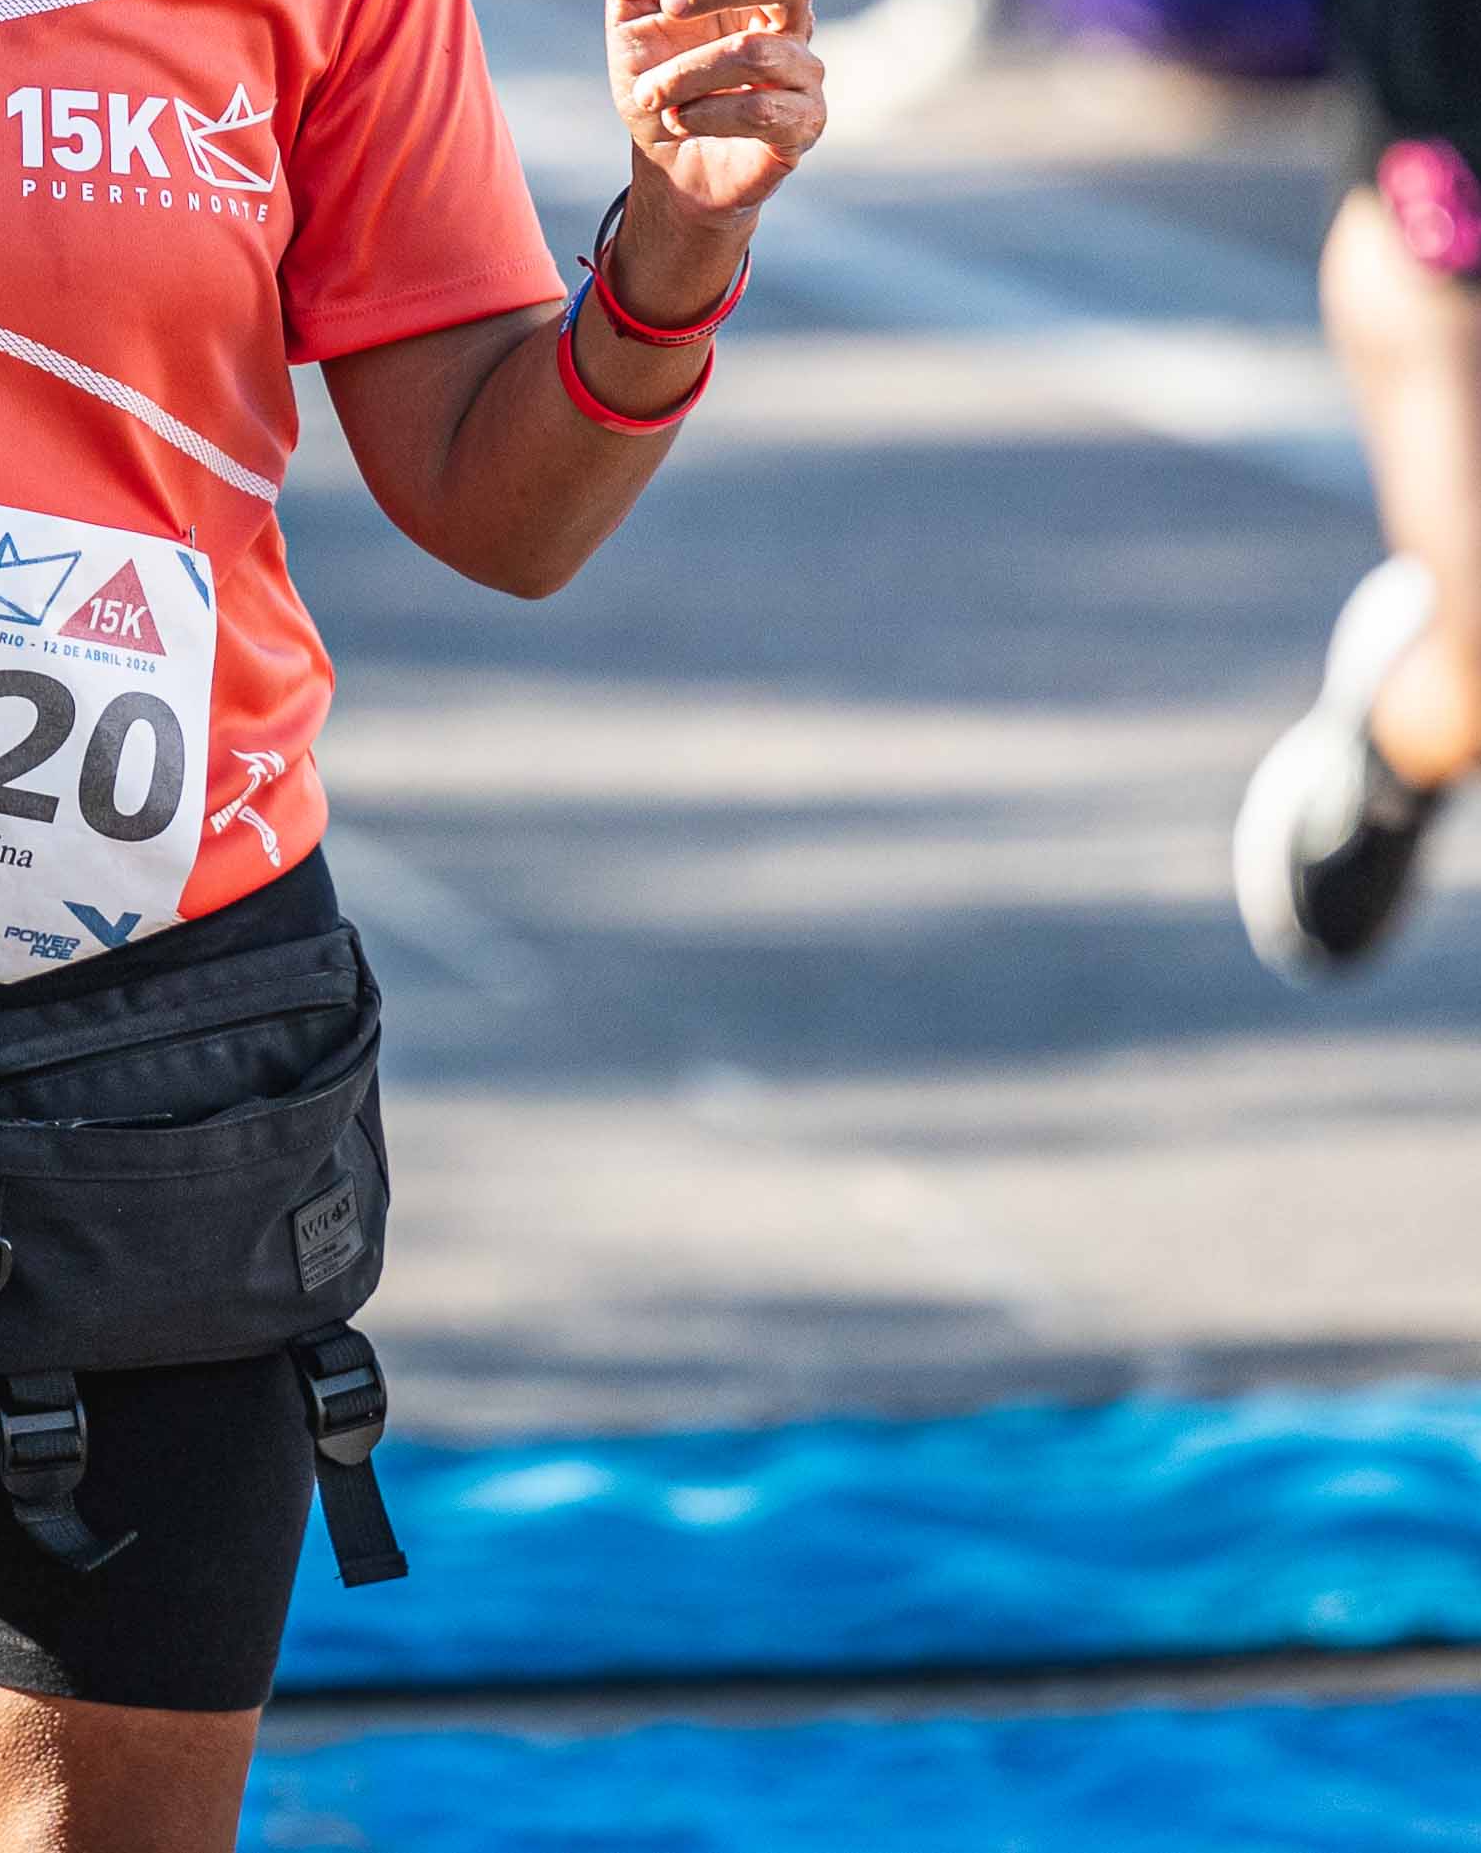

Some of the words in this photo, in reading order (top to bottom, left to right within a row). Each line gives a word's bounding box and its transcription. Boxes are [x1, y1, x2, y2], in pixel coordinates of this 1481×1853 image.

[6, 86, 172, 179] 15K
[87, 597, 150, 639] 15K
[44, 640, 58, 653] 12
[63, 645, 79, 658] DE
[85, 649, 122, 667] ABRIL
[126, 658, 157, 673] 2026
[4, 926, 81, 950] POWER
